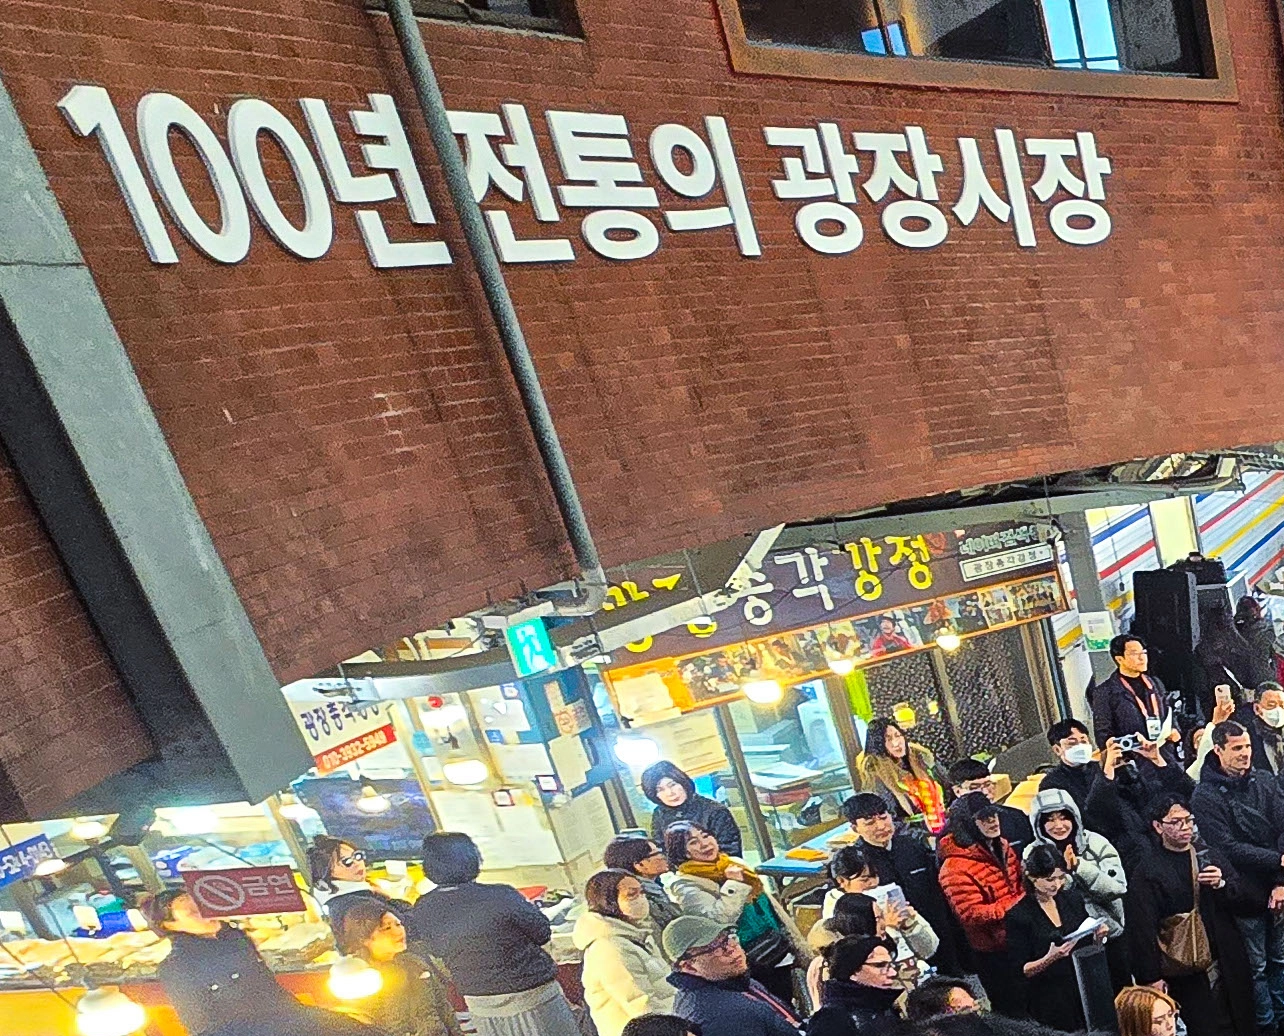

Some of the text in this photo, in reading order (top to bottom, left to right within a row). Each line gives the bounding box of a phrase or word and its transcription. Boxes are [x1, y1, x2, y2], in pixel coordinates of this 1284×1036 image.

[57, 85, 1112, 268] 100년 전통의 광장시장
[844, 535, 933, 602] 강정
[300, 701, 380, 741] 광장총각
[241, 872, 295, 897] 금연
